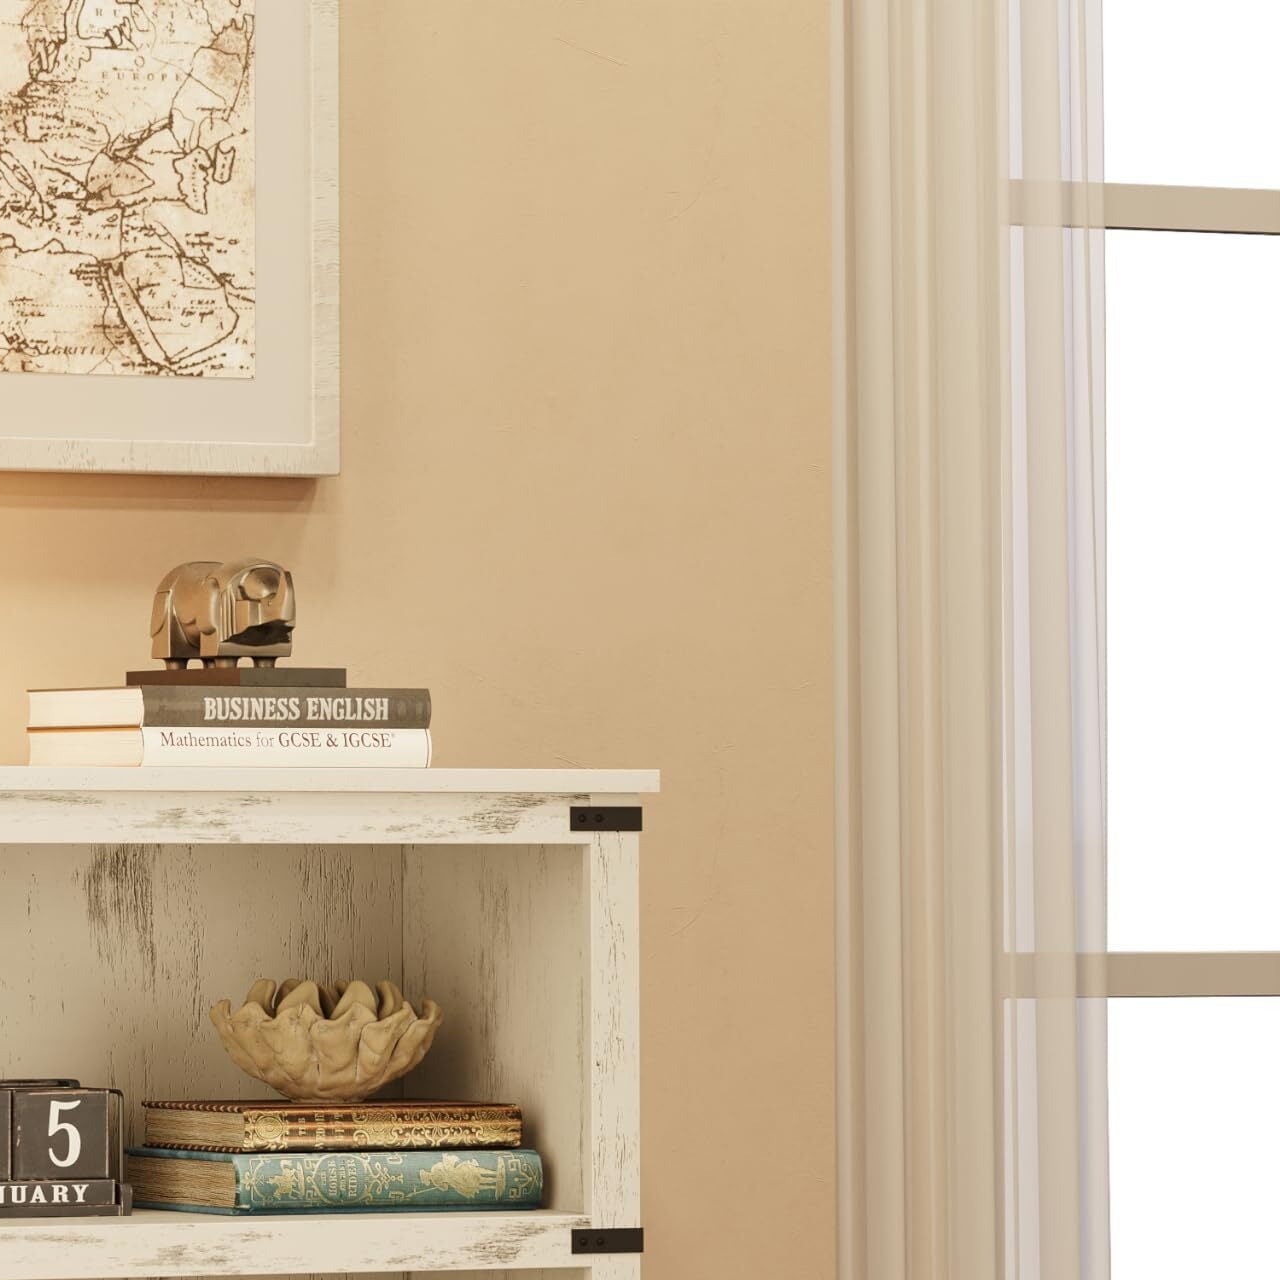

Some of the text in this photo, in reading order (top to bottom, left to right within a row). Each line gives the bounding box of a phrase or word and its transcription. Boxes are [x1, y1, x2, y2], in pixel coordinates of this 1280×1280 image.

[203, 697, 389, 721] BUSINESS ENGLISH
[160, 731, 251, 748] Mathematics
[255, 731, 274, 748] for
[278, 732, 322, 748] GCSE
[326, 732, 339, 748] &
[328, 1160, 337, 1197] HORSE
[347, 1159, 357, 1198] RIDER
